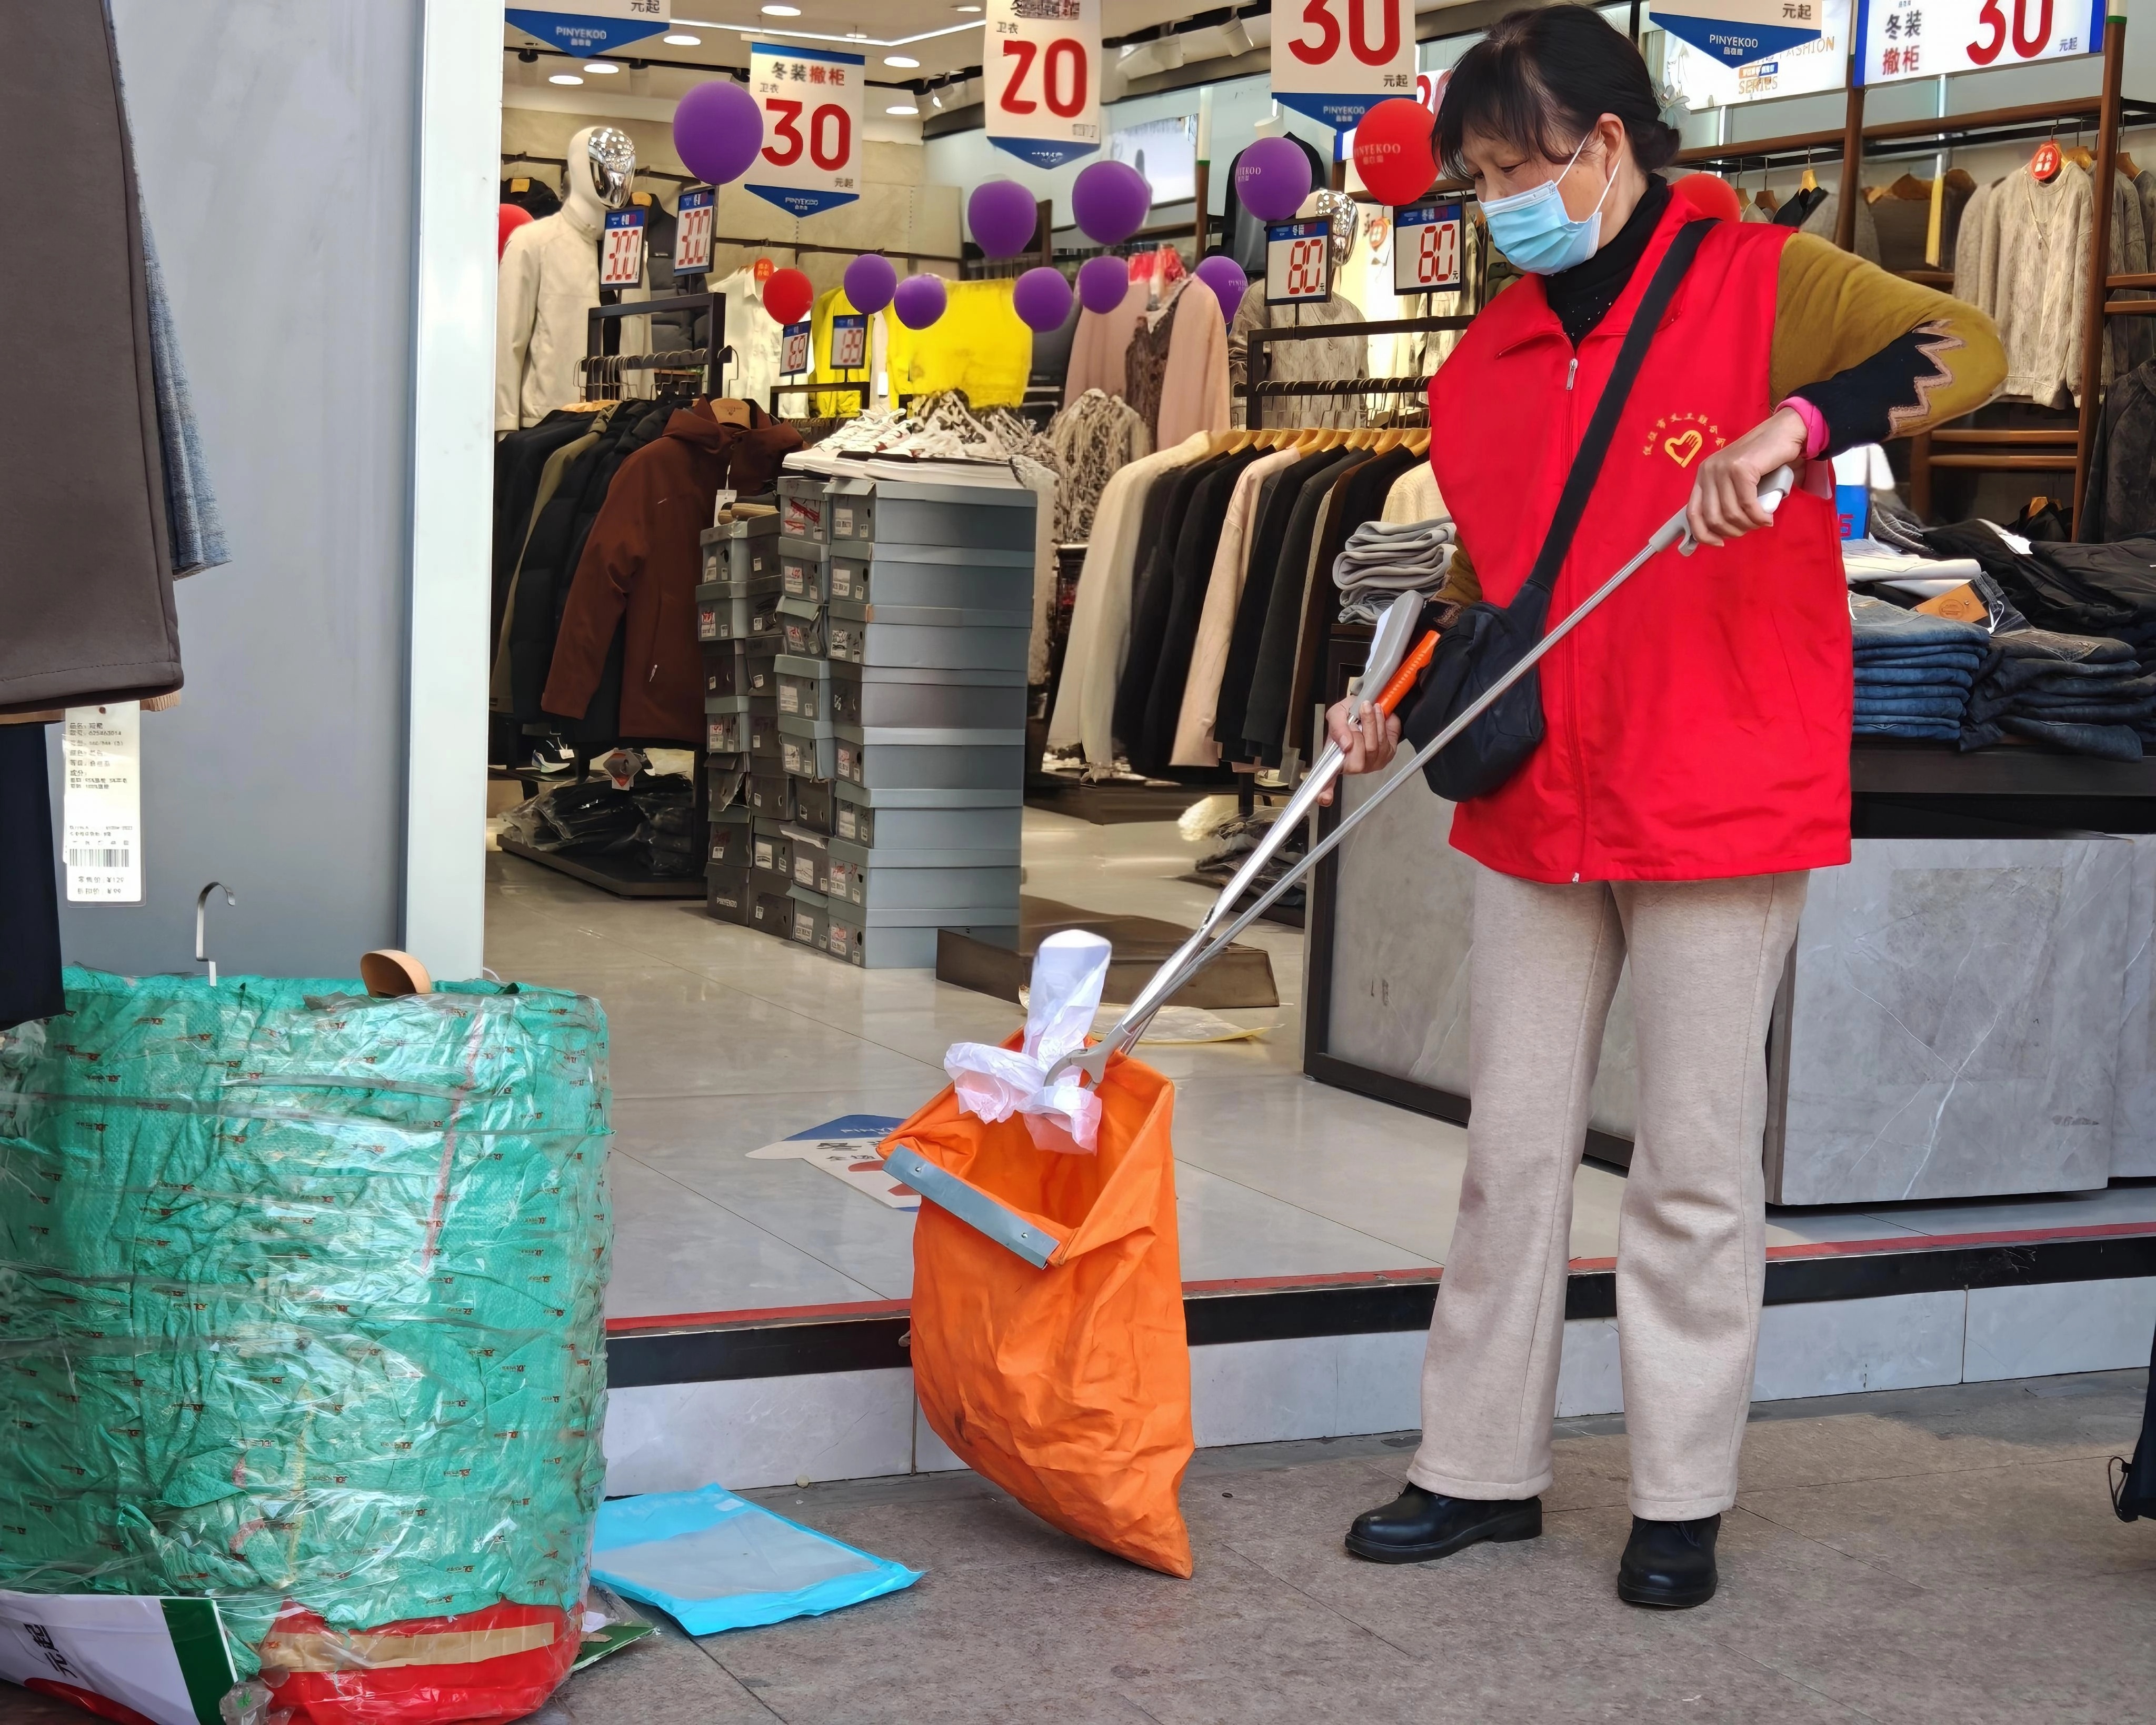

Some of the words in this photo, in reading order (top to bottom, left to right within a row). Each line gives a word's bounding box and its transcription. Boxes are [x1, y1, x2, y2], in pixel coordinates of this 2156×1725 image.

[1782, 4, 1812, 20] 元起
[556, 26, 606, 39] PINYEKOO
[996, 22, 1019, 34] 卫衣
[1288, 0, 1401, 66] 30
[1885, 9, 1922, 40] 冬装
[1967, 0, 2053, 65] 30
[1710, 34, 1758, 48] PINYEKOO
[2059, 37, 2078, 52] 元起
[1883, 45, 1921, 75] 撤柜
[772, 62, 845, 86] 冬装撤柜
[1383, 74, 1409, 88] 元起
[760, 82, 779, 94] 卫衣
[1323, 105, 1365, 115] PINYEKOO
[761, 98, 851, 171] 30
[1418, 224, 1455, 283] 80
[1289, 239, 1323, 295] 80
